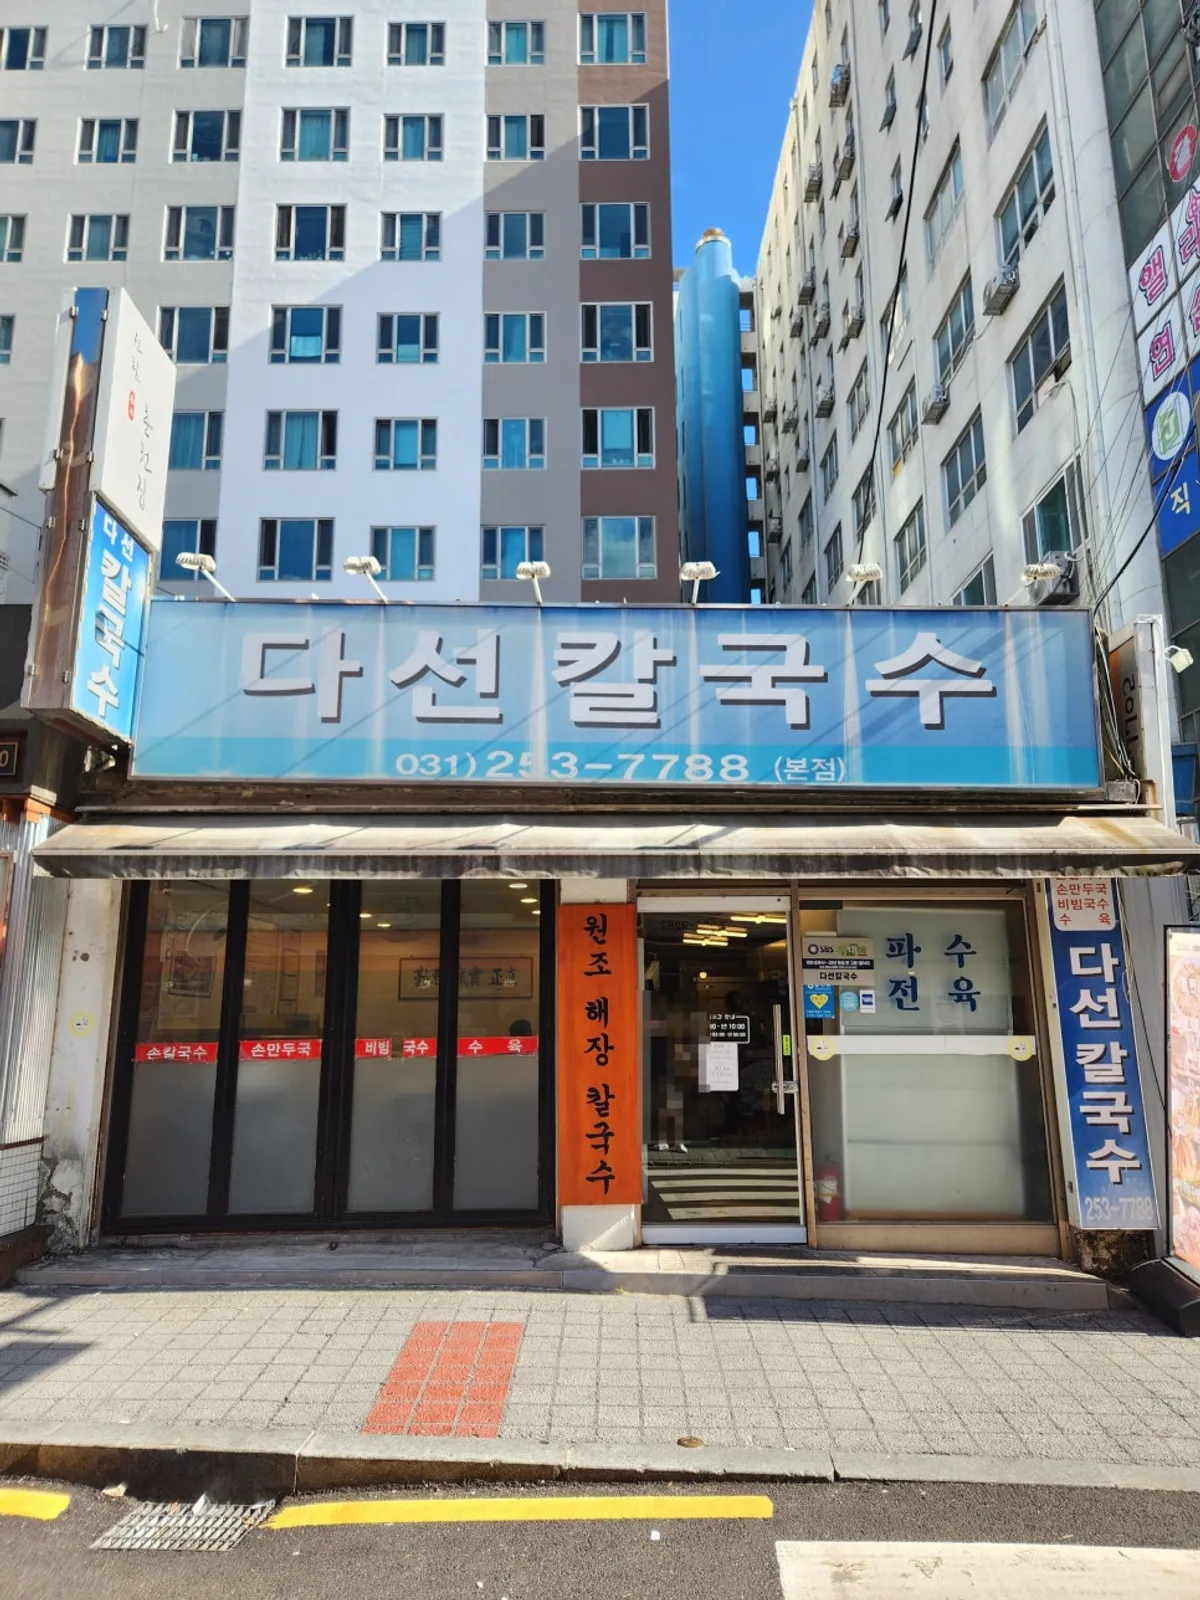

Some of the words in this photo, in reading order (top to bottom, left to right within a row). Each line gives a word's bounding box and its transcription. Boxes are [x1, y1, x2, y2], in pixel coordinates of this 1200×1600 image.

[103, 513, 134, 562] 다선
[87, 549, 132, 718] 칼국수
[240, 623, 997, 729] 다선칼국수
[774, 756, 846, 783] (본점)
[1056, 883, 1108, 896] 손만두국
[1057, 897, 1109, 911] 비빔국수
[583, 913, 612, 977] 원조
[820, 971, 858, 981] 다선칼국수
[584, 997, 615, 1067] 해장
[146, 1046, 208, 1061] 손칼국수
[250, 1041, 312, 1058] 손만두국
[365, 1039, 390, 1056] 비빔
[403, 1039, 429, 1055] 국수
[1068, 942, 1142, 1184] 다선칼국수
[585, 1083, 615, 1195] 칼국수
[1084, 1196, 1154, 1221] 253-7788
